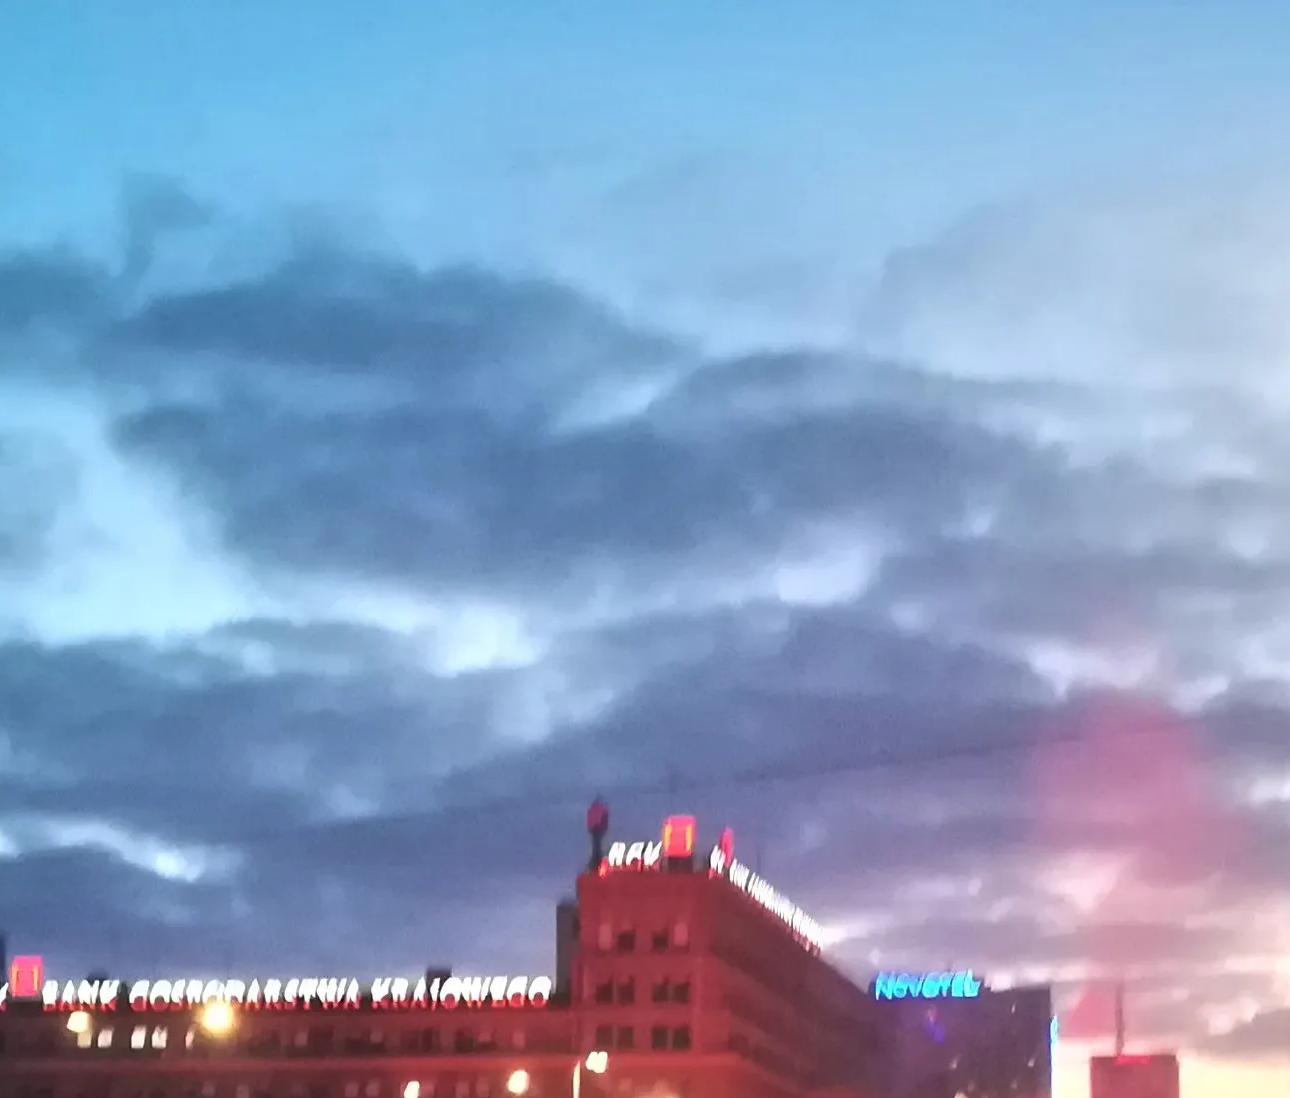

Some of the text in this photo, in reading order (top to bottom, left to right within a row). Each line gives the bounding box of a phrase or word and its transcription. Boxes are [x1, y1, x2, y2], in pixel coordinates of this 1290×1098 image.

[42, 980, 120, 1012] BANK
[371, 976, 552, 1010] KRAJOWEGO
[875, 969, 981, 1000] NOVOTEL
